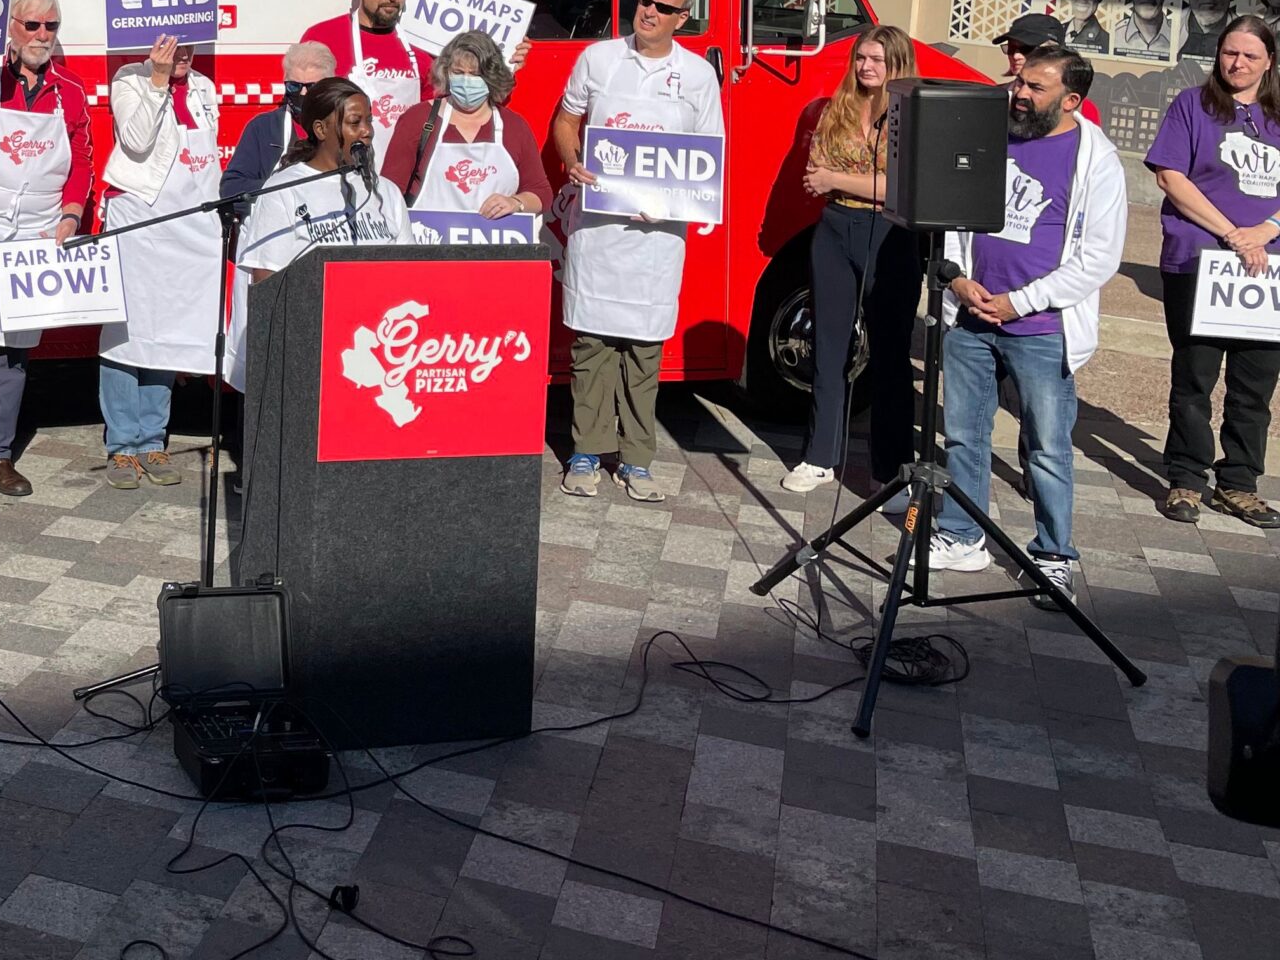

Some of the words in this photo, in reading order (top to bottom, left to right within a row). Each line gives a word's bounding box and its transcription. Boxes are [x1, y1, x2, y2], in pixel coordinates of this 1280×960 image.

[111, 10, 215, 29] GERRYMANDERING!
[10, 132, 55, 155] Gerry's
[634, 145, 717, 182] END
[1006, 213, 1029, 223] MAPS
[449, 227, 528, 245] END
[3, 248, 48, 268] FAIR
[56, 245, 111, 265] MAPS
[10, 265, 109, 300] NOW!
[376, 318, 531, 387] Gerry's
[415, 368, 467, 379] PARTISAN
[415, 377, 468, 393] PIZZA
